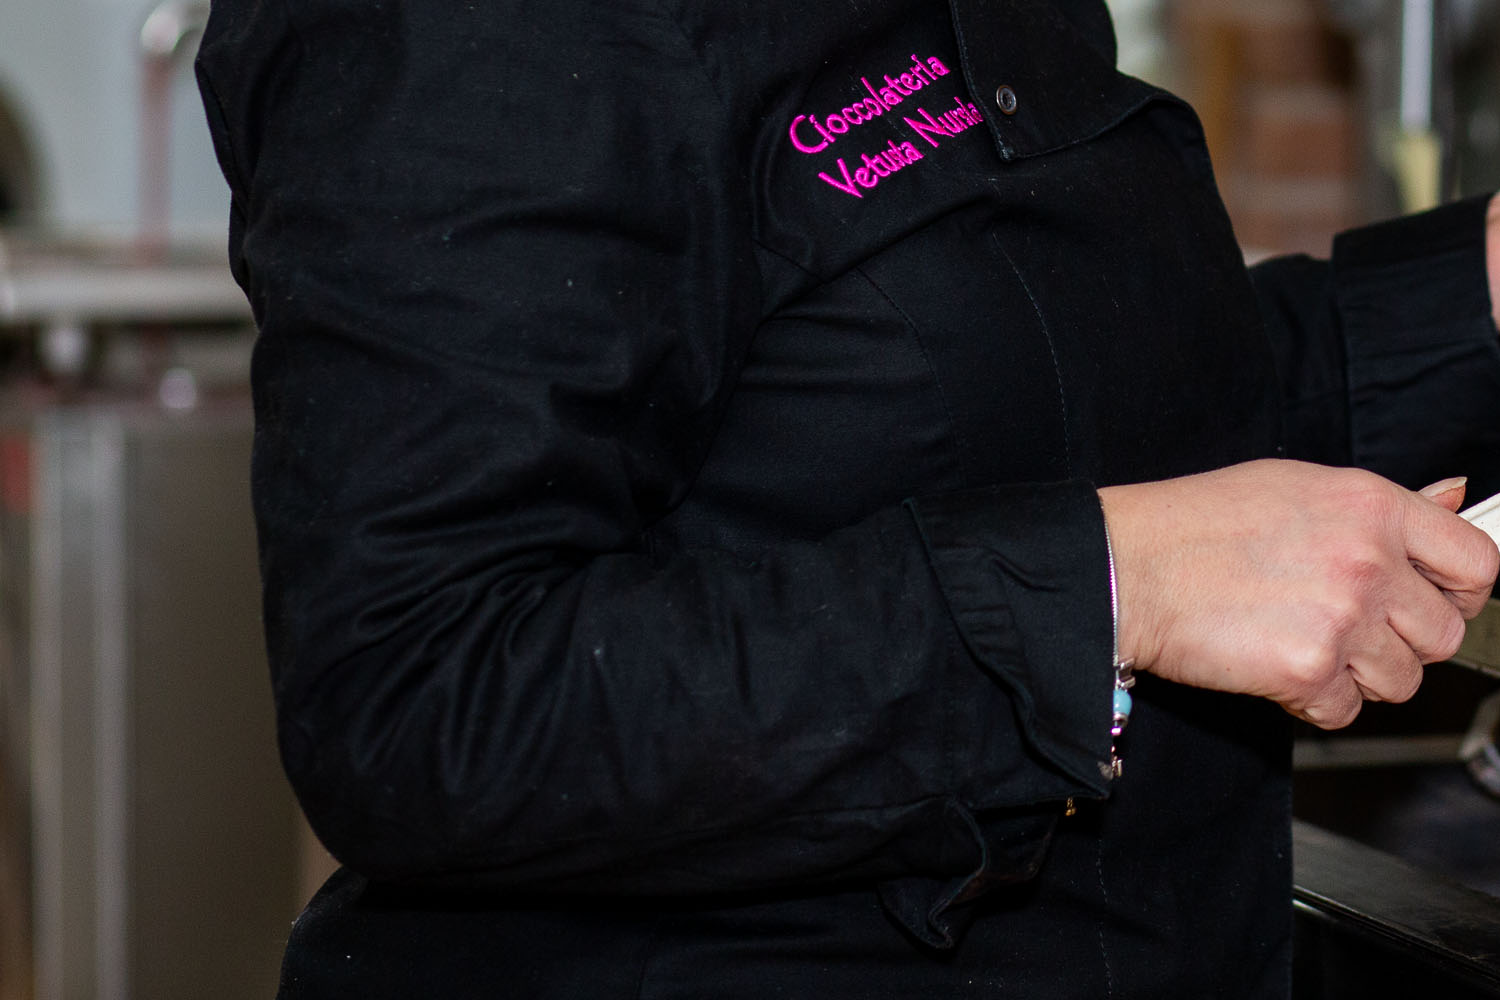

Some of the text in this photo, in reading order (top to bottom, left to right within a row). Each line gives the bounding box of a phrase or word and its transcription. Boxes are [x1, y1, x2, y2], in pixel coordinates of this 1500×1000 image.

[789, 54, 950, 154] Cioccolateria
[818, 96, 984, 198] Vetusta Nursia
